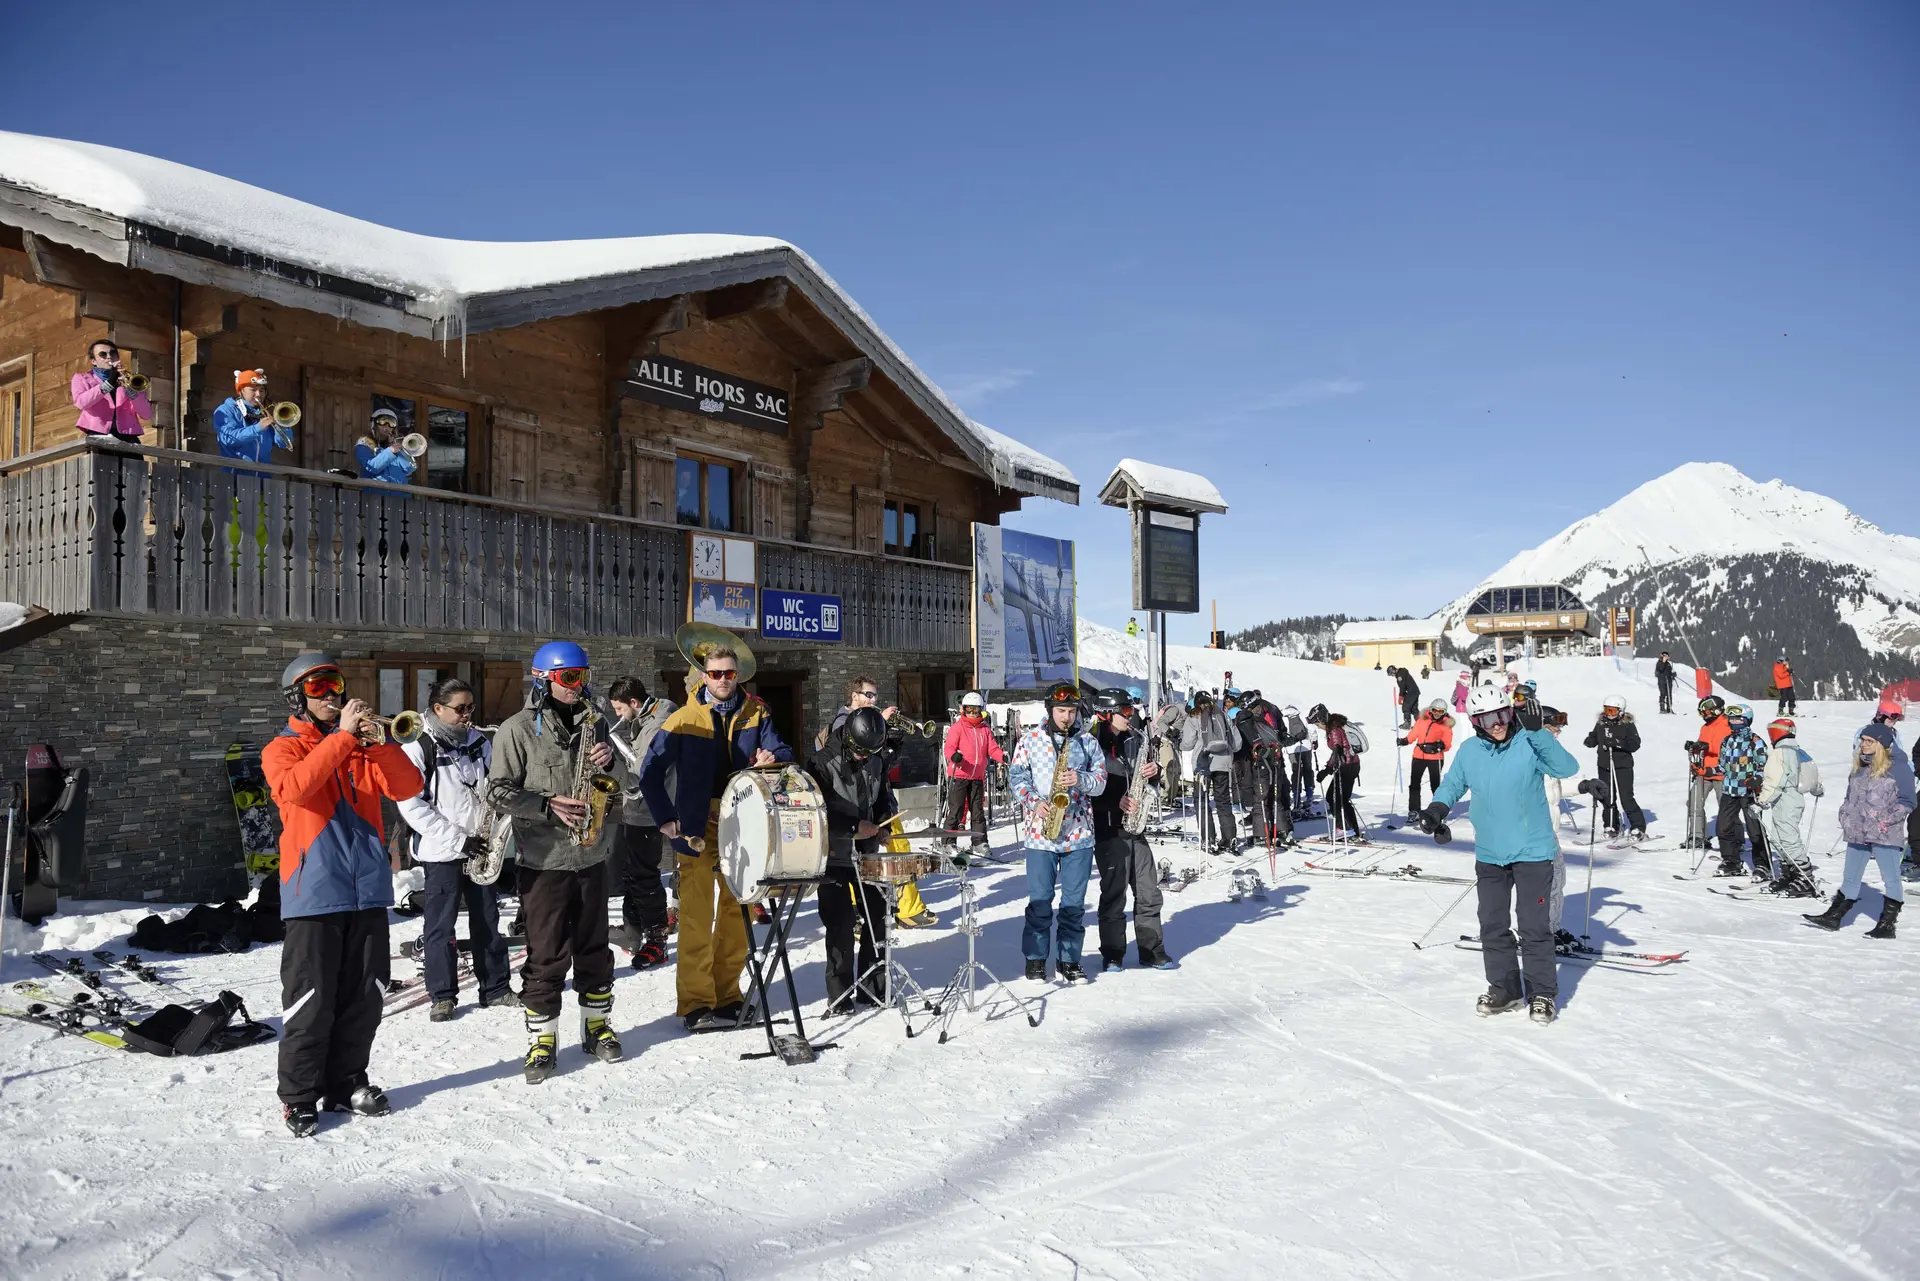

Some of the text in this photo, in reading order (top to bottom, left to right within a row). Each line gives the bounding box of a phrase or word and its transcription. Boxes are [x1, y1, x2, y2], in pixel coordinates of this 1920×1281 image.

[633, 359, 684, 388] ALLE
[695, 374, 746, 404] HORS
[755, 392, 787, 416] SAC
[725, 586, 743, 598] PIZ
[783, 598, 804, 615] WC
[765, 614, 819, 633] PUBLICS
[735, 784, 754, 805] SONOR
